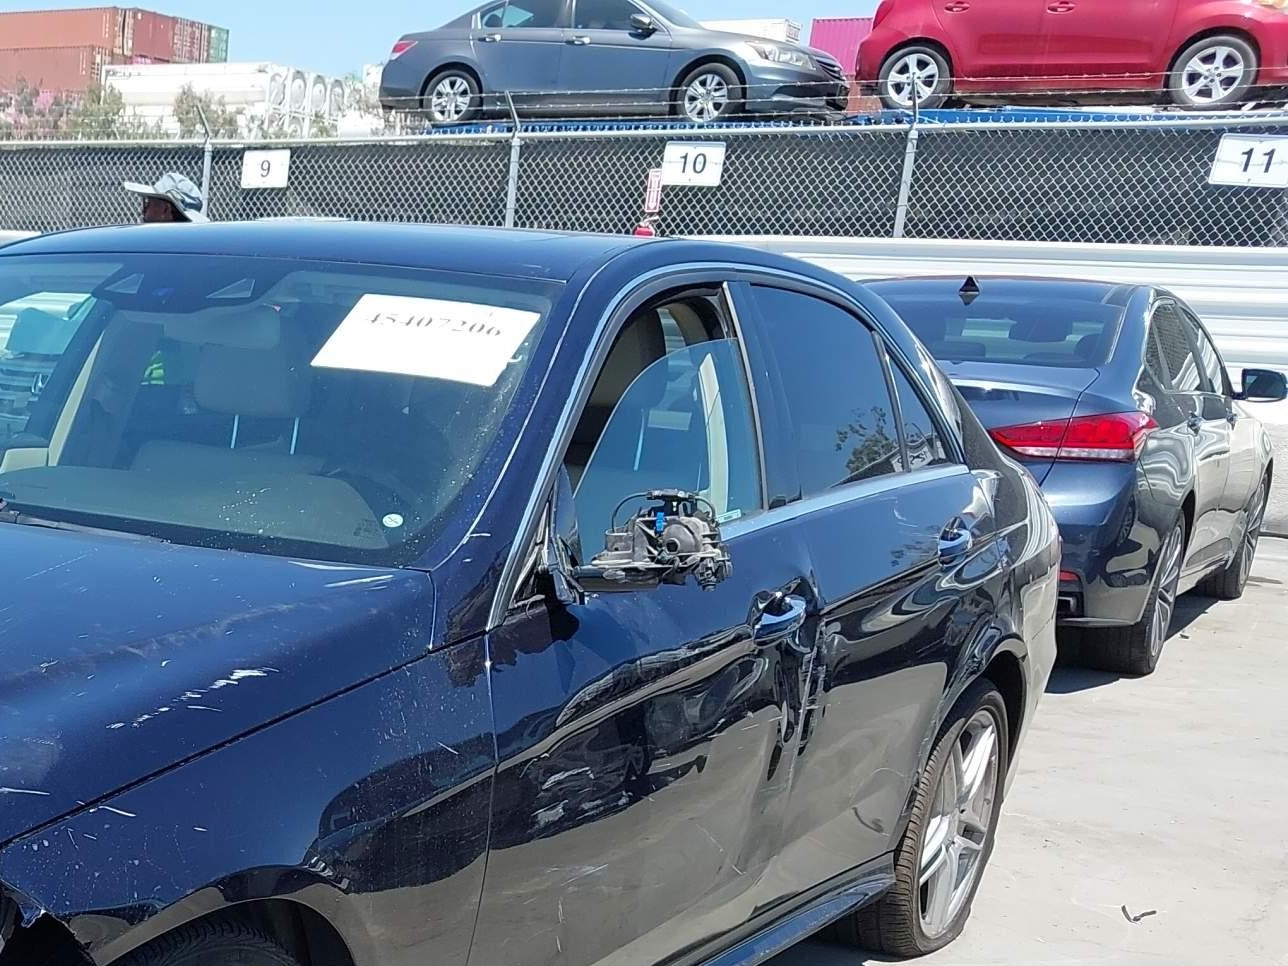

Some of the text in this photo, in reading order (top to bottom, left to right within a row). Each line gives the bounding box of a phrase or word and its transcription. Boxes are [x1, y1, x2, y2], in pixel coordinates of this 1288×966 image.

[260, 159, 271, 178] 9
[679, 152, 707, 174] 10
[1241, 147, 1276, 173] 11
[366, 311, 501, 337] 45407206
